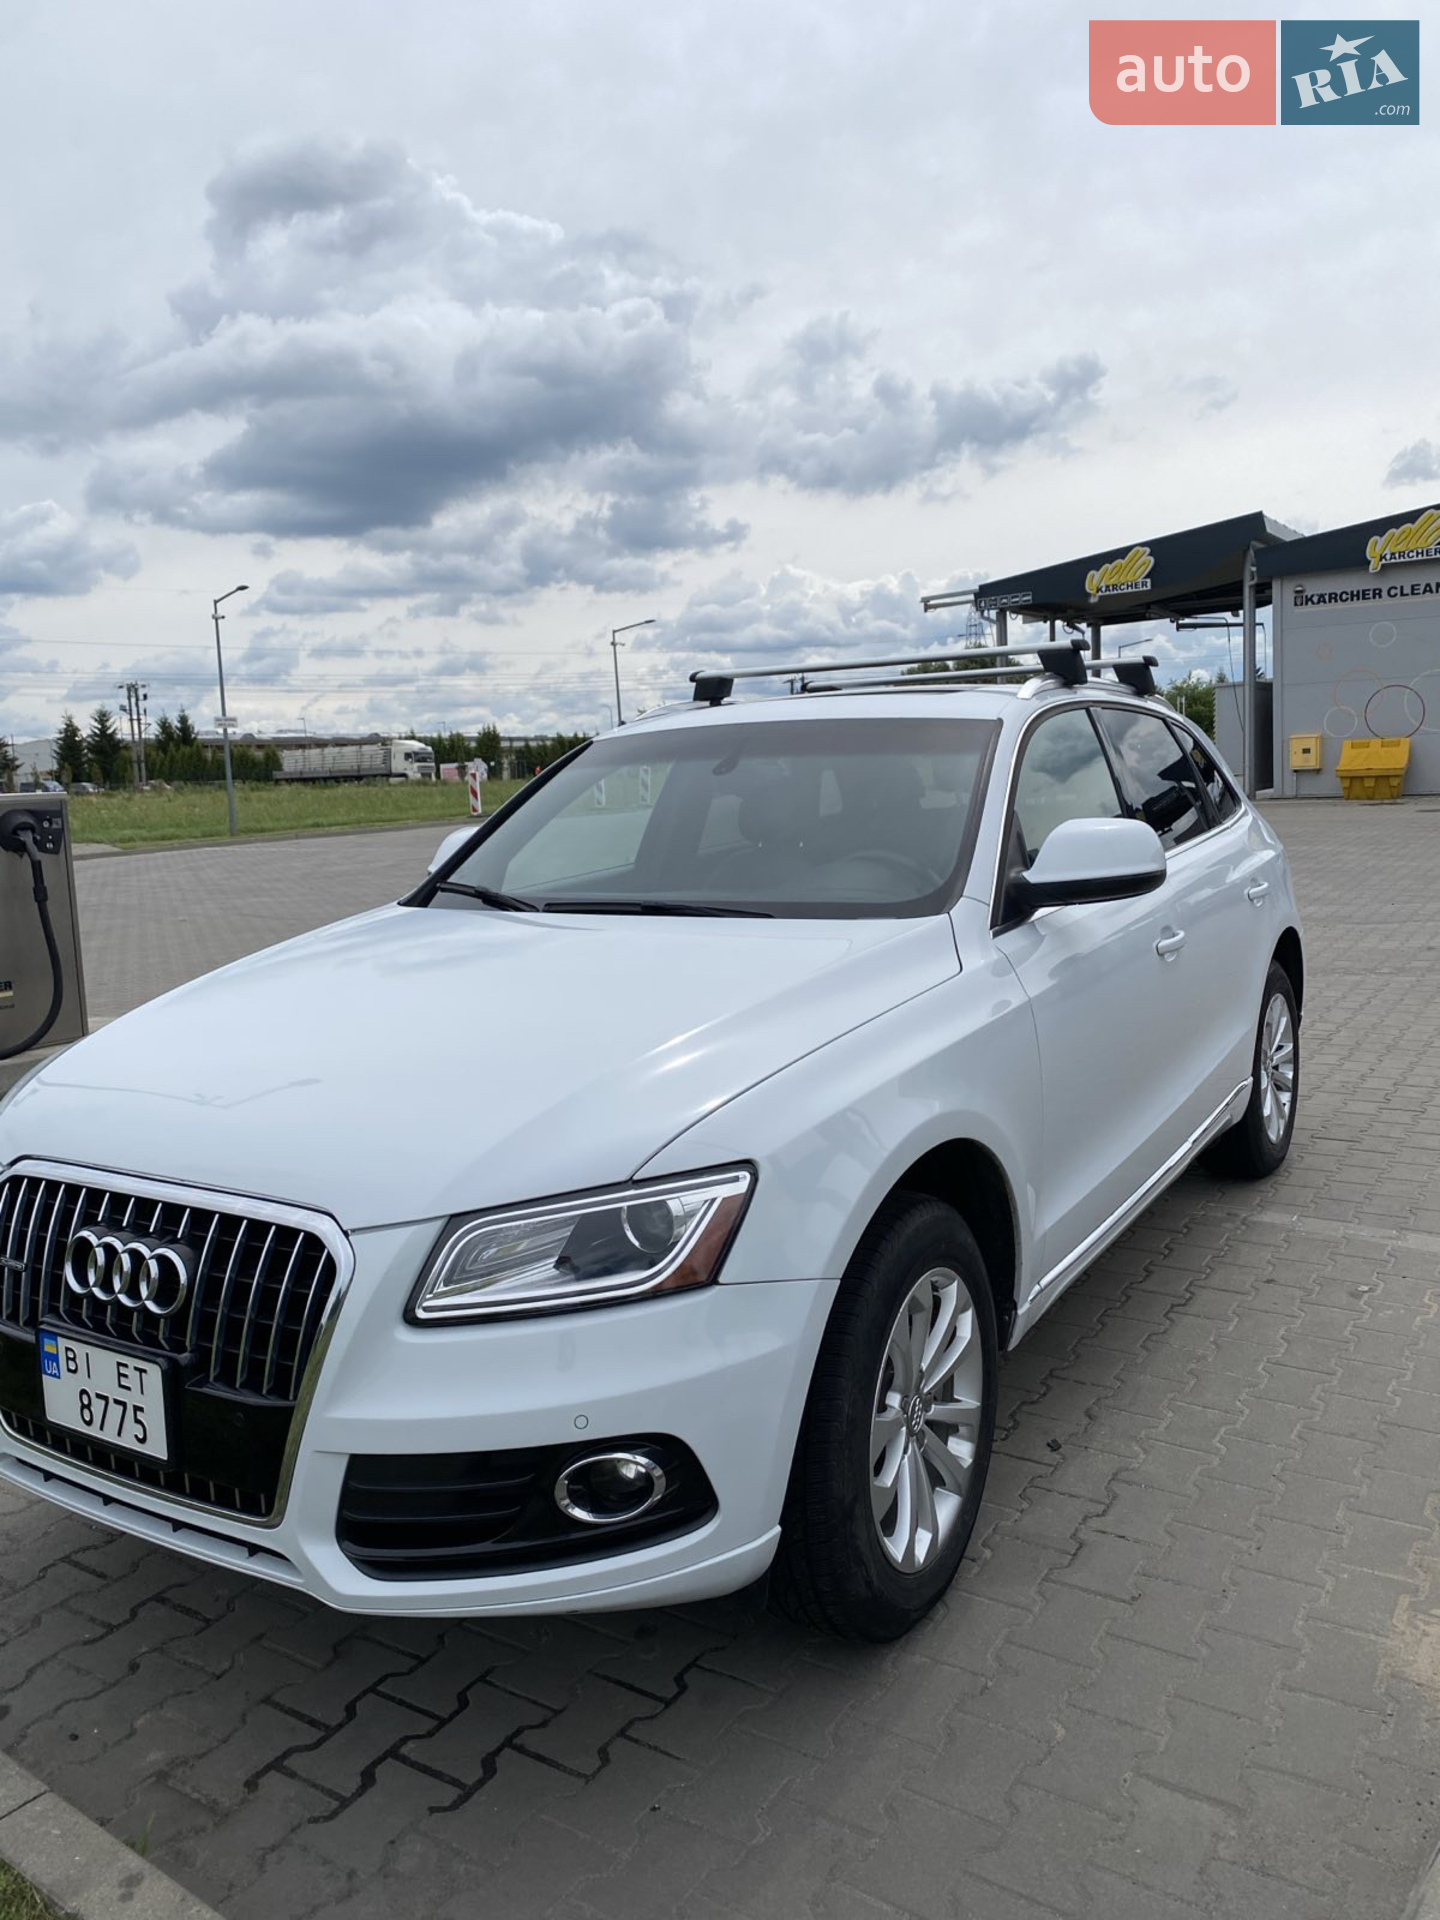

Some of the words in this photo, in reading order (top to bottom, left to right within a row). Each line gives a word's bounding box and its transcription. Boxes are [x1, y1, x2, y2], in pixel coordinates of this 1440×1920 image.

[1305, 588, 1383, 606] KÄRCHER
[44, 1359, 60, 1377] UA
[65, 1346, 91, 1380] BI
[116, 1360, 148, 1396] ET
[78, 1387, 148, 1445] 8775
